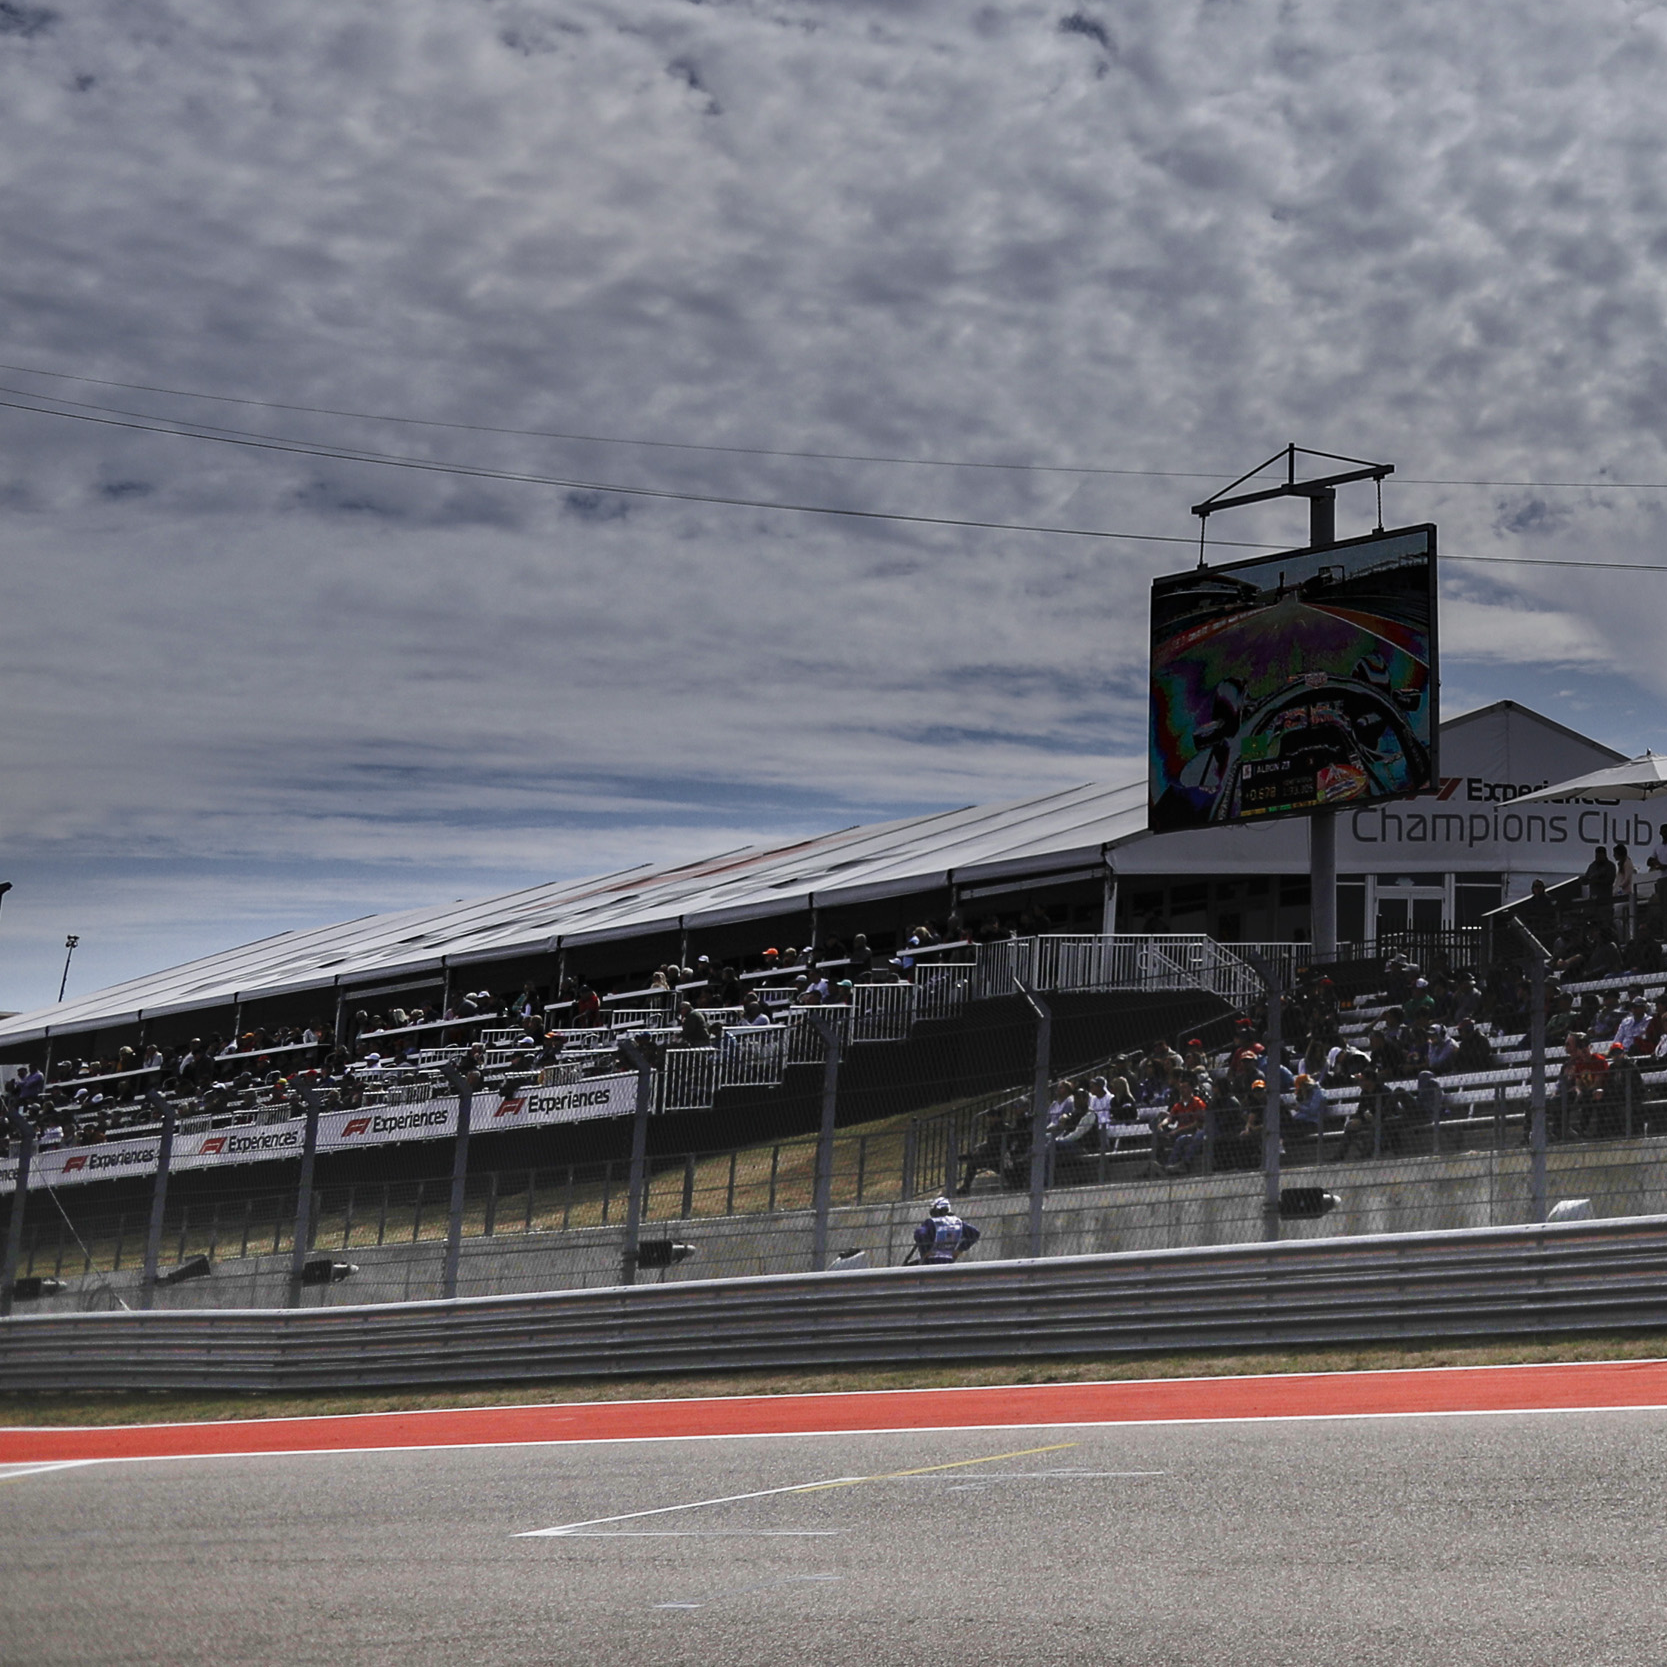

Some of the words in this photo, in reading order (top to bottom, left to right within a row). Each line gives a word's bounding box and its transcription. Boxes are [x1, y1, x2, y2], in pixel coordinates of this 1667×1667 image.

[1352, 807, 1568, 847] Champions
[1578, 811, 1652, 846] Club
[528, 1088, 610, 1115] Experiences
[373, 1109, 448, 1134] Experiences
[229, 1130, 298, 1153] Experiences
[89, 1148, 154, 1170] Experiences
